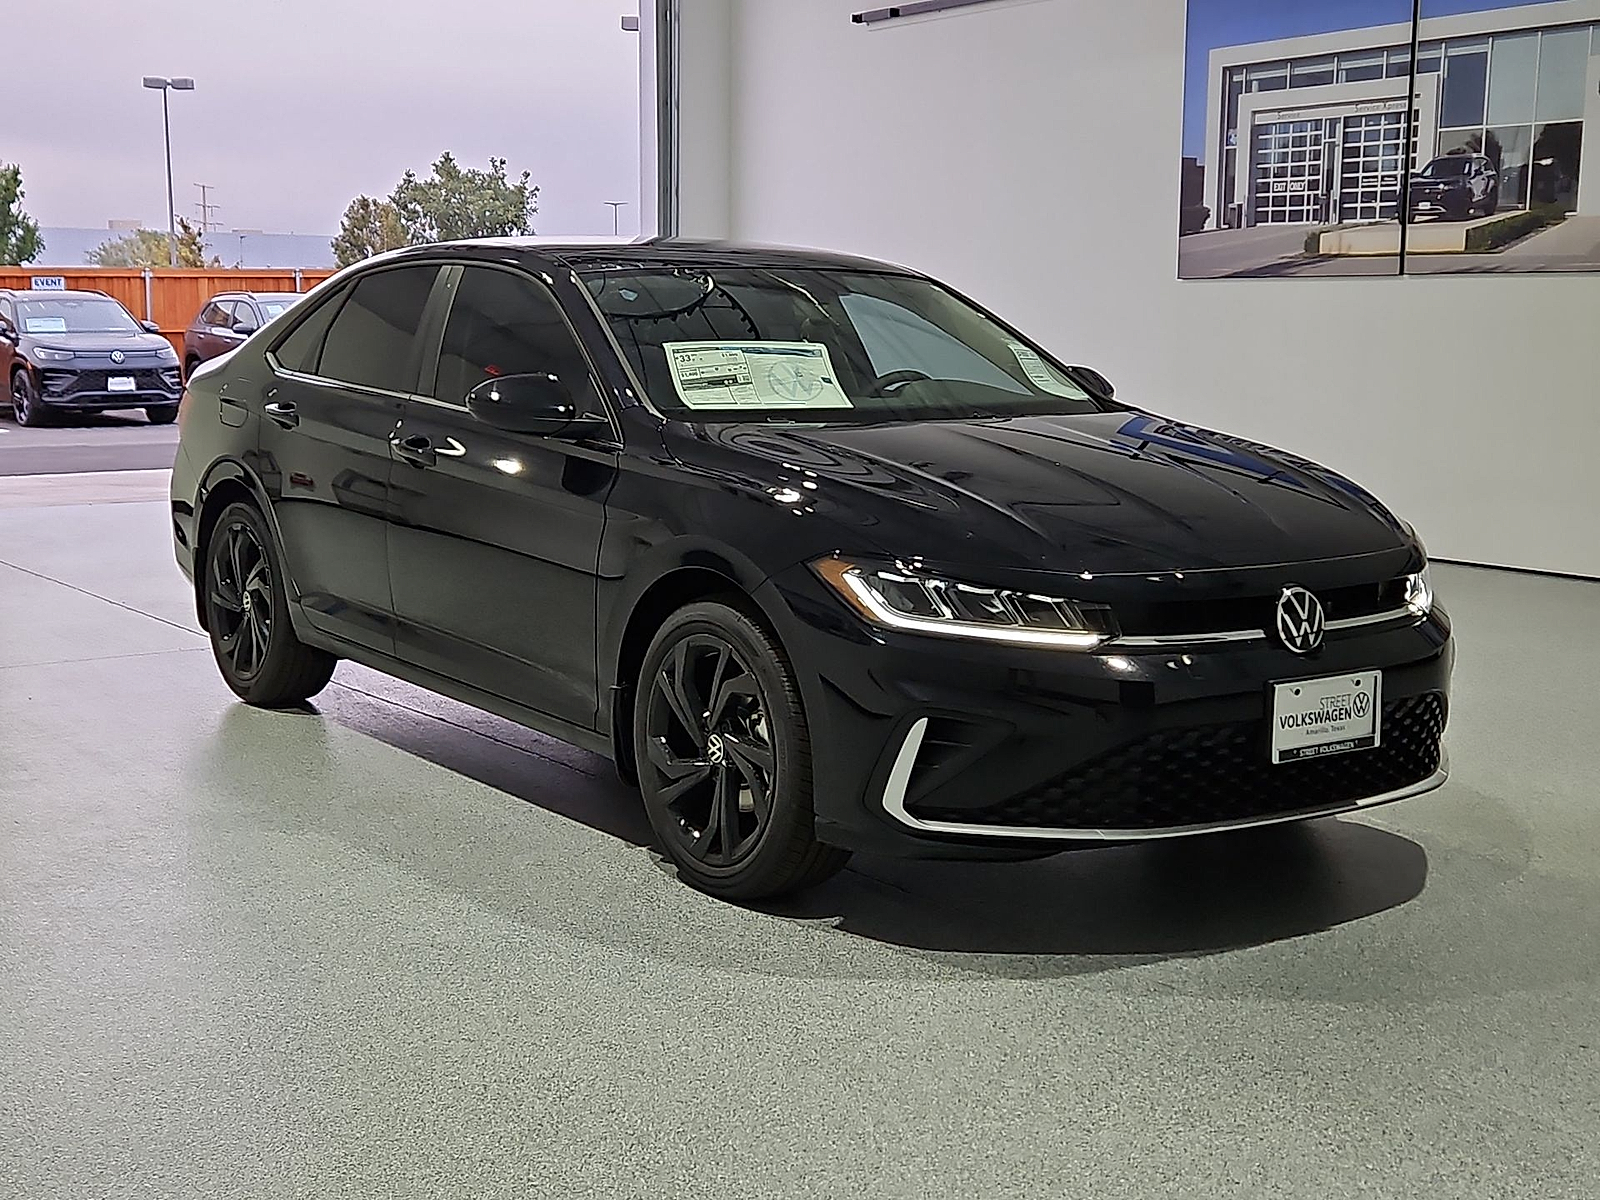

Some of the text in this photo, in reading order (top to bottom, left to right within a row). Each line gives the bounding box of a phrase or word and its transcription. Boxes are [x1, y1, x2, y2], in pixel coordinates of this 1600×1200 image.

[34, 278, 62, 287] EVENT
[679, 354, 692, 363] 33
[1319, 693, 1352, 710] STREET
[1279, 707, 1353, 730] VOLKSWAGEN
